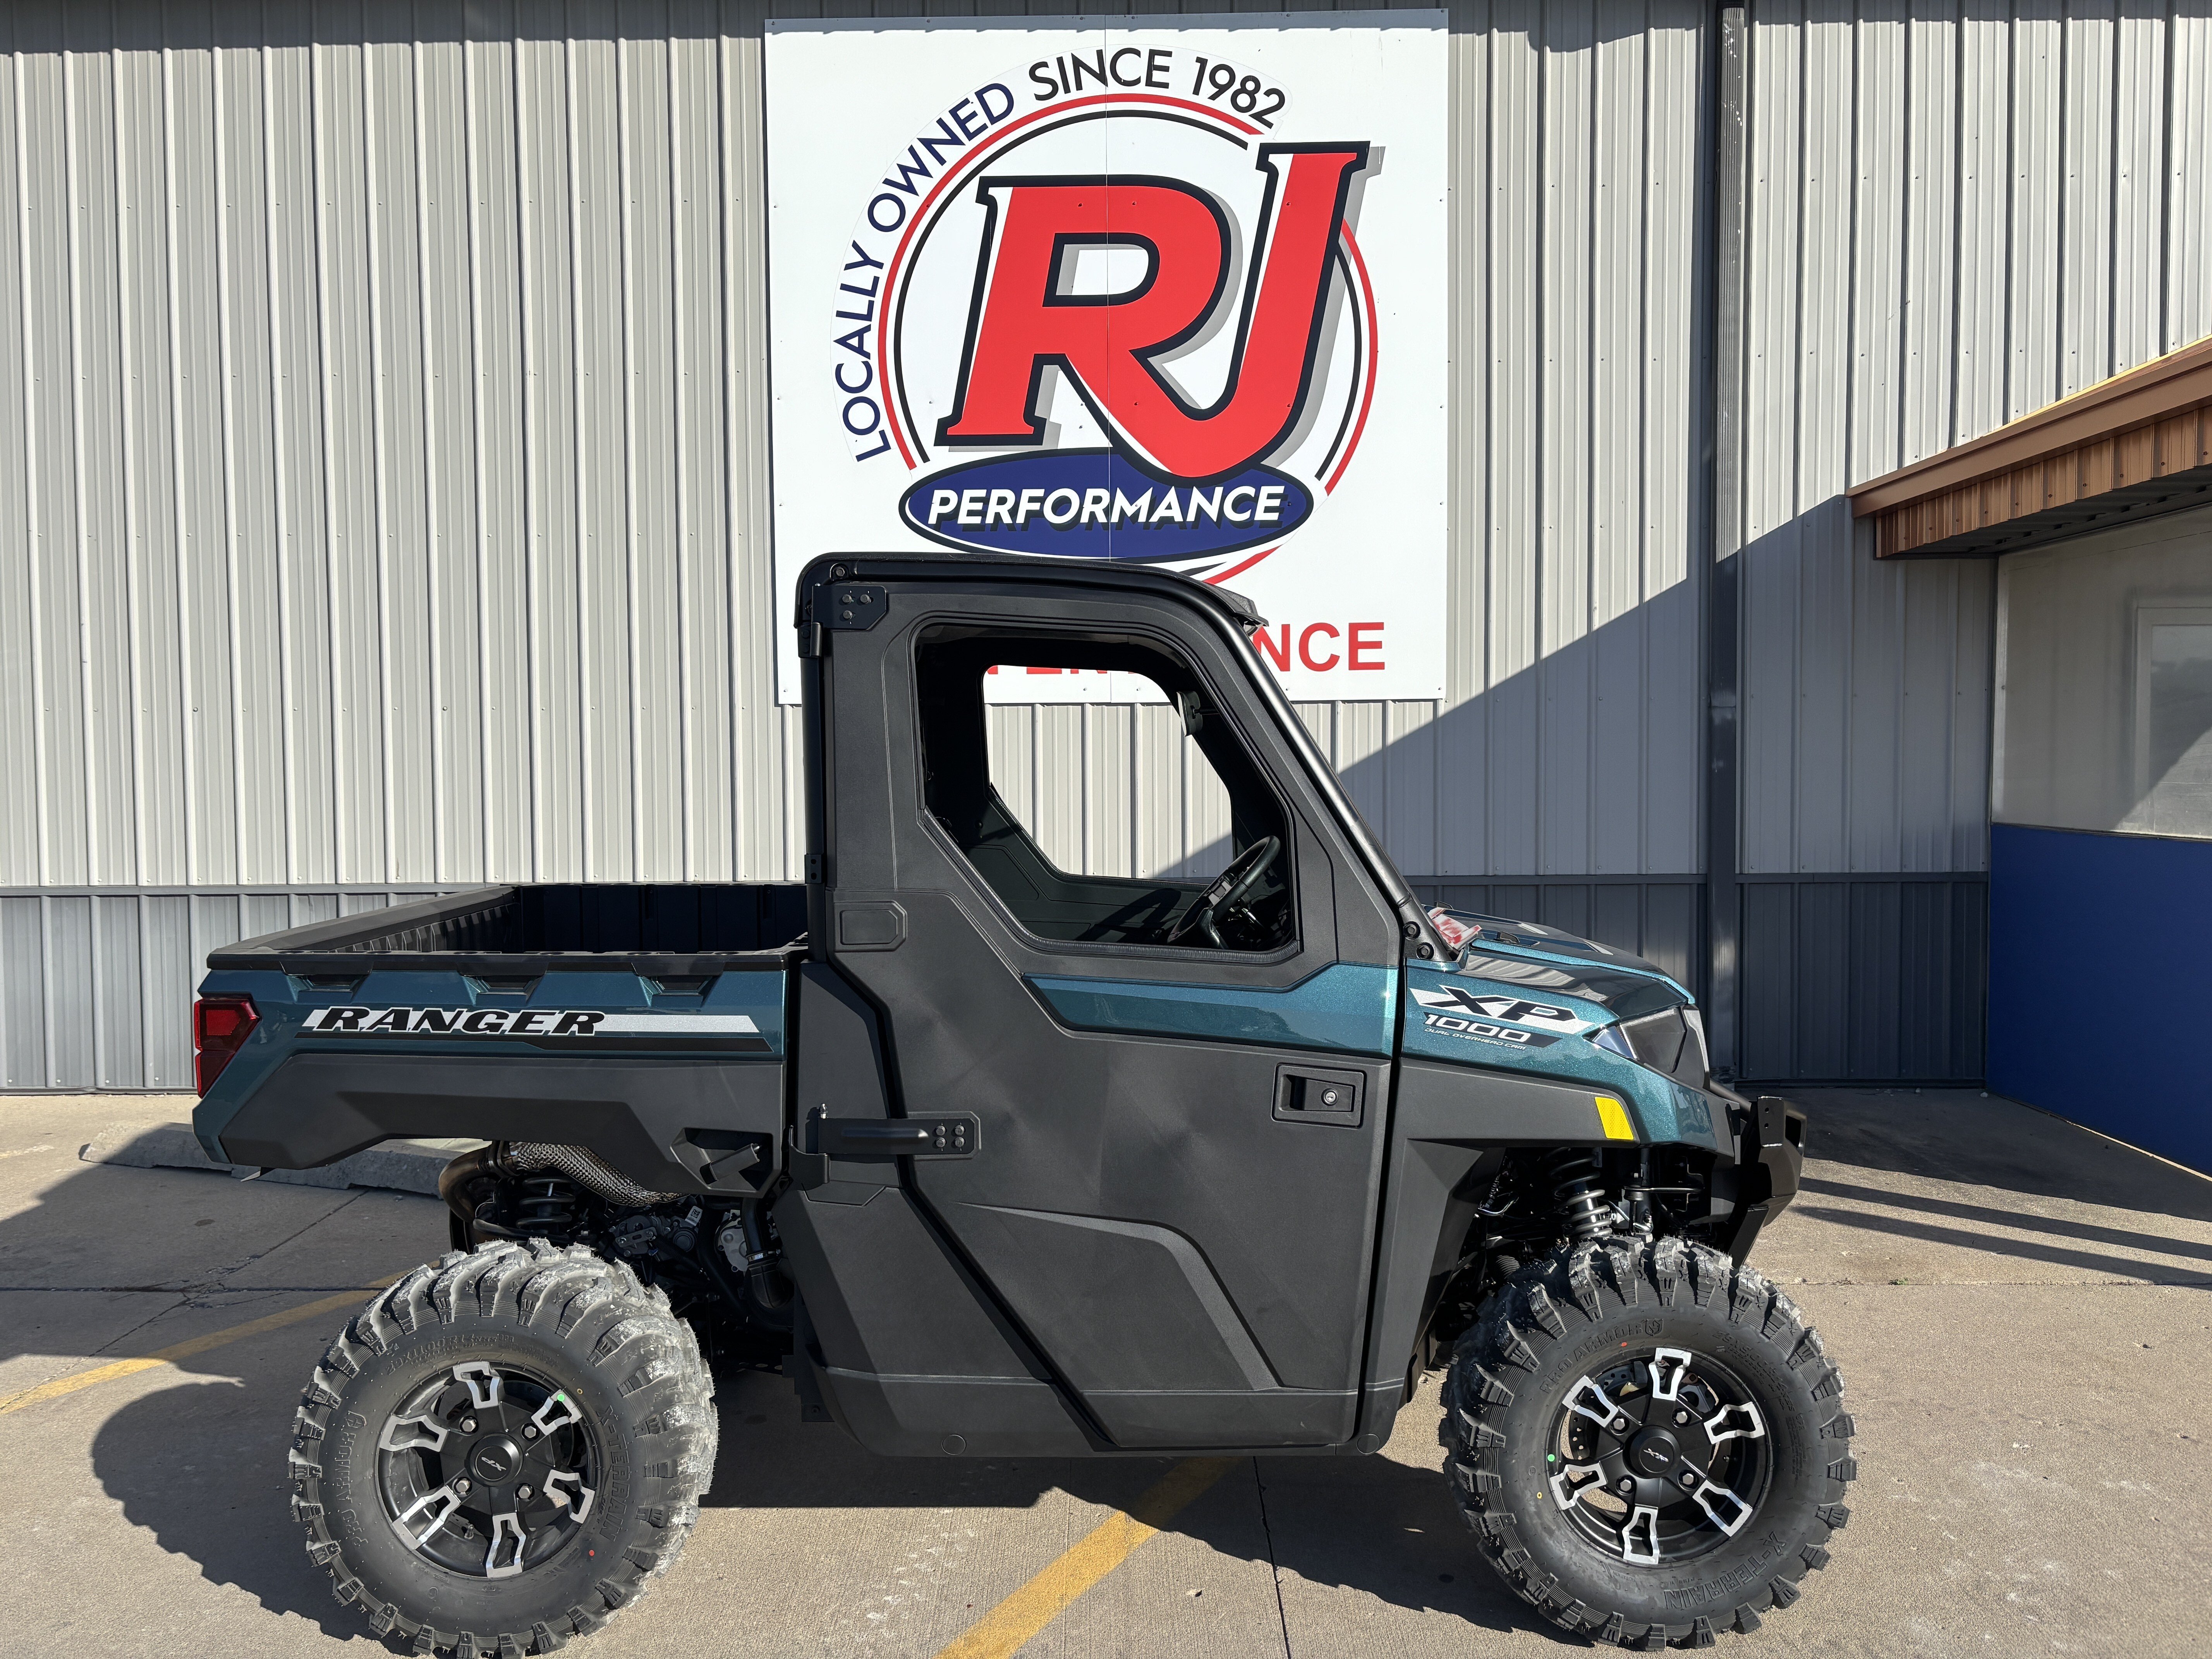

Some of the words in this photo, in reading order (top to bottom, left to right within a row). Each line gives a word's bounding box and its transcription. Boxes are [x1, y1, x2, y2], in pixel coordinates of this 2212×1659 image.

[833, 240, 891, 462] LOCALLY
[867, 83, 1014, 232] OWNED
[1029, 48, 1173, 101] SINCE
[1192, 57, 1285, 129] 1982
[934, 141, 1370, 485] RJ
[928, 486, 1285, 524] PERFORMANCE
[315, 1006, 605, 1036] RANGER
[1420, 984, 1578, 1022] XP
[1424, 1014, 1531, 1042] 1000
[1424, 1028, 1450, 1036] DUAL
[1452, 1033, 1503, 1046] OVERHEAD
[1663, 1530, 1787, 1610] X-TERRAIN
